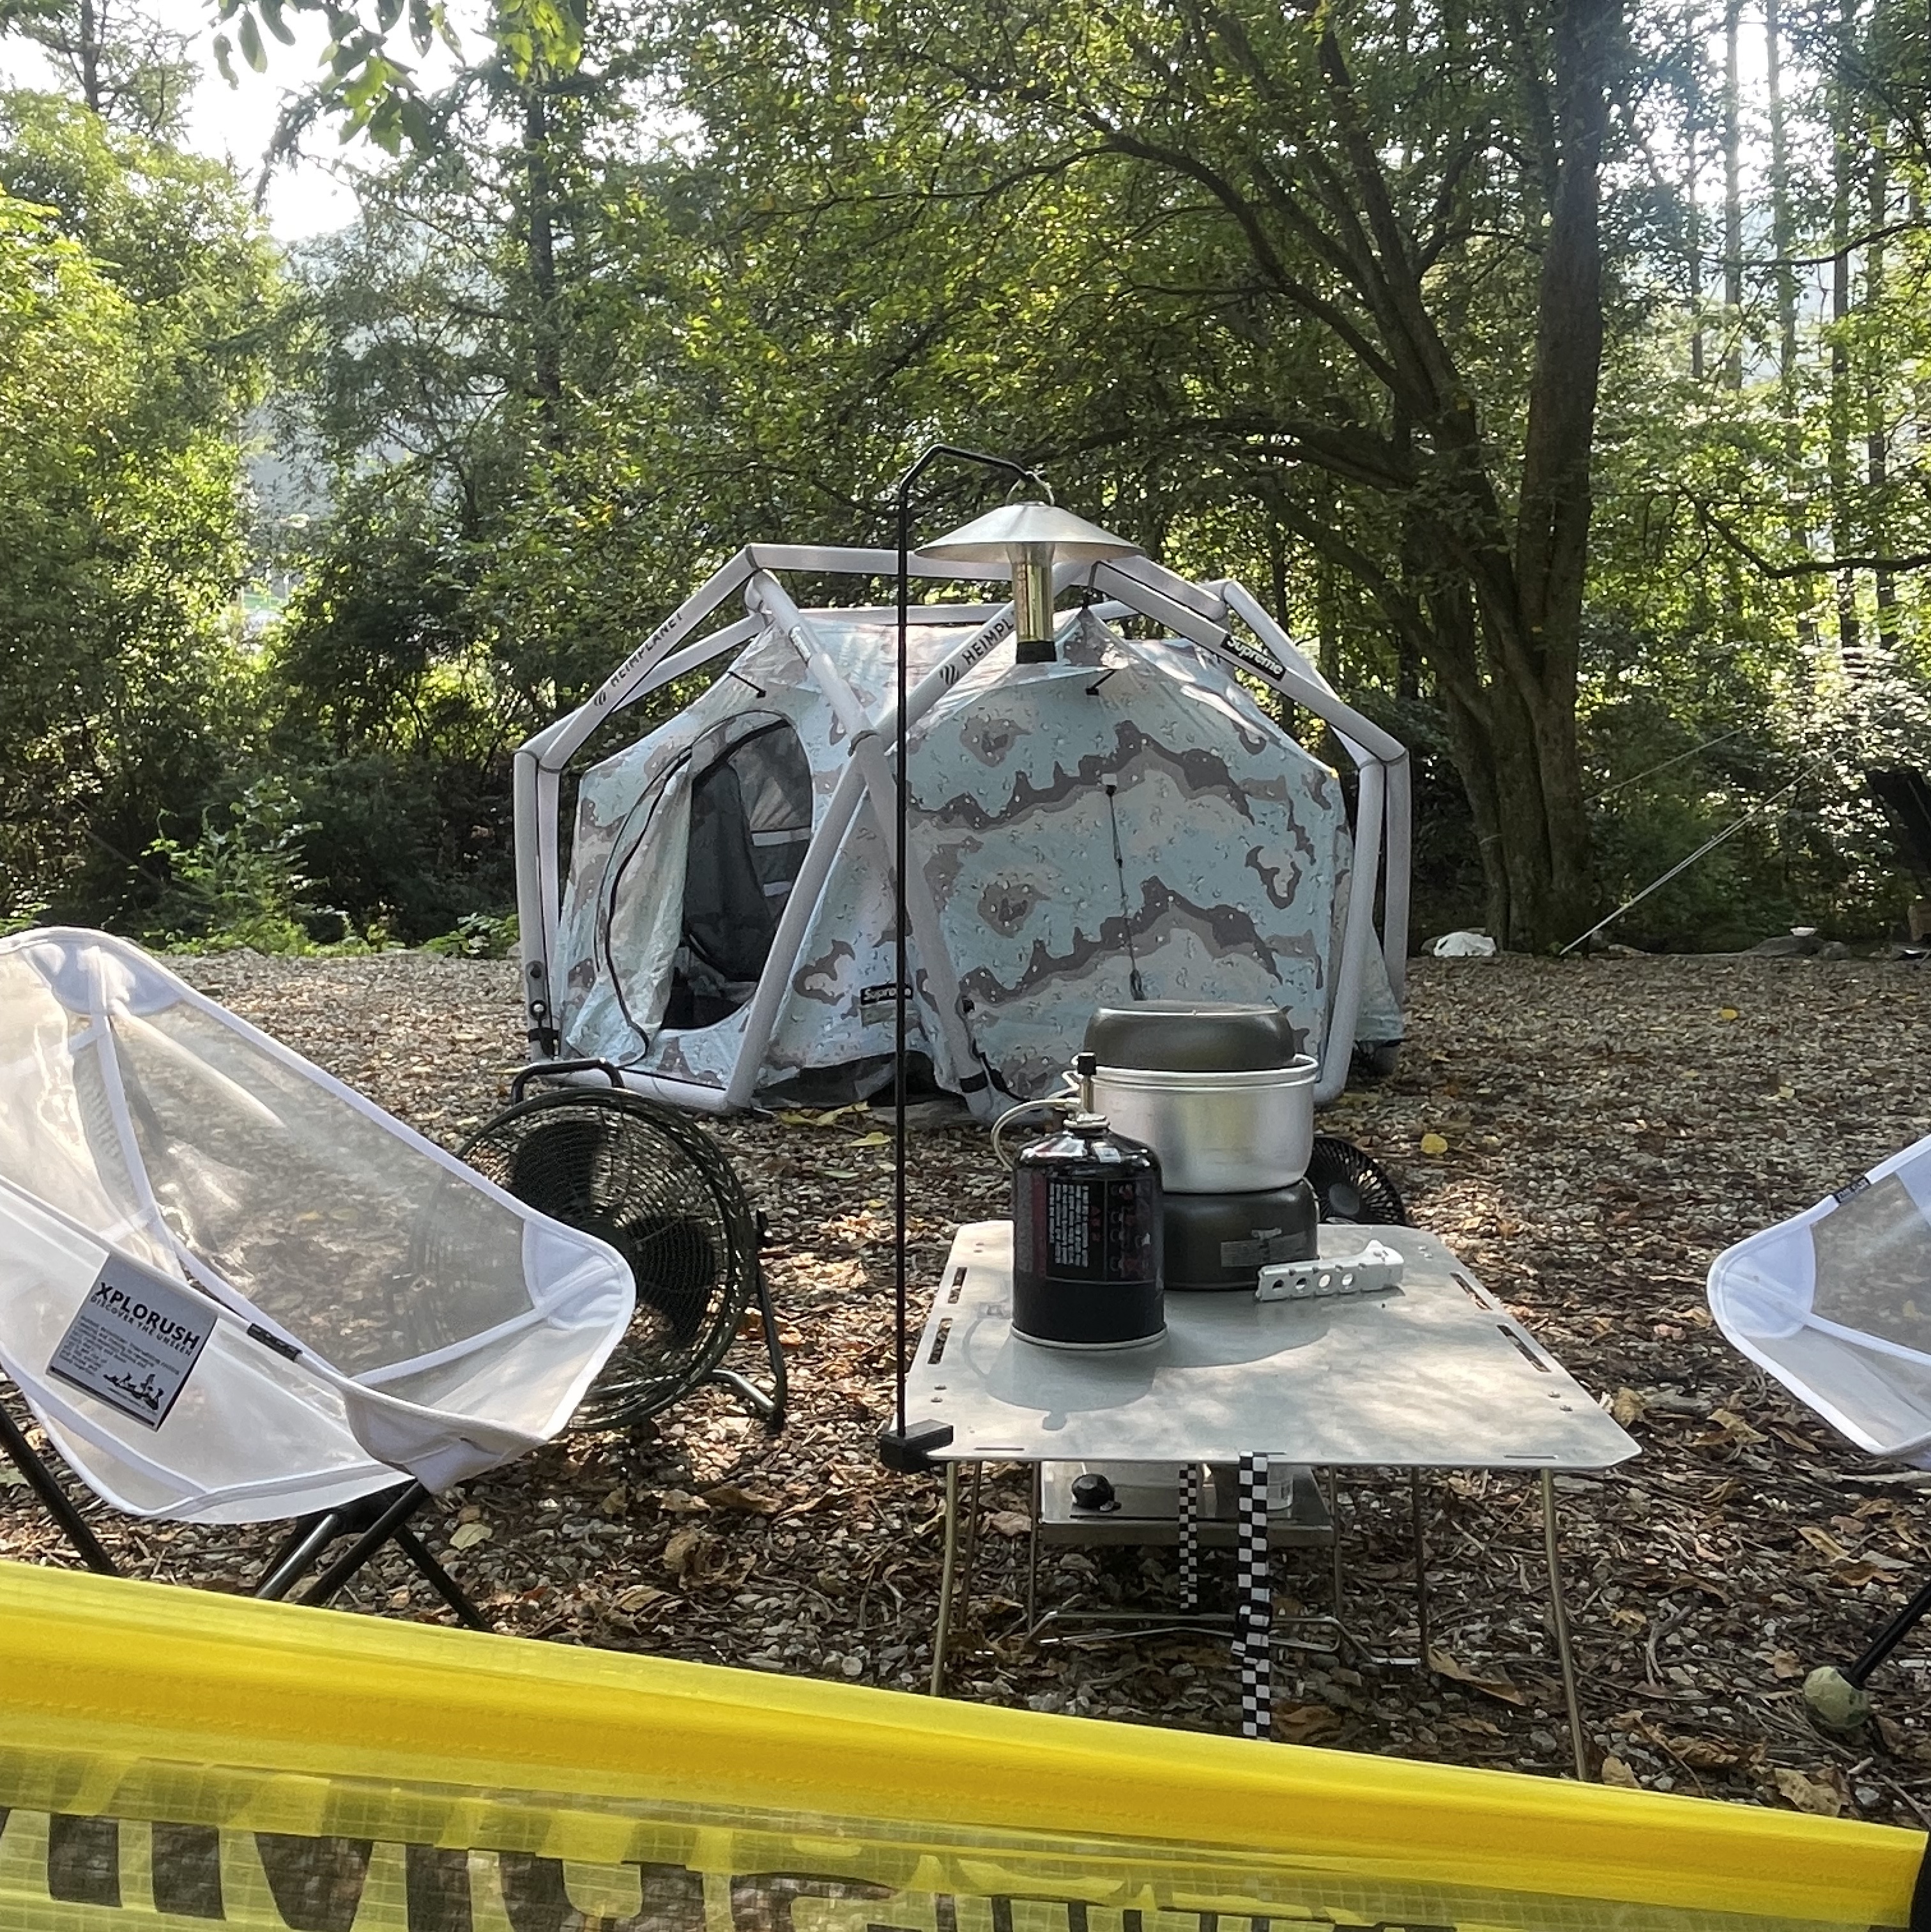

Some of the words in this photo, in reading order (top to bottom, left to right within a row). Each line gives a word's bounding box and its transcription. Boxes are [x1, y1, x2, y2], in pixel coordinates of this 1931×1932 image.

[610, 612, 683, 687] HEIMPLANET
[961, 613, 1015, 666] HEIMPL
[1227, 636, 1283, 675] Supreme
[864, 987, 912, 1002] Supree
[90, 1295, 134, 1324] DISCOVER
[137, 1321, 155, 1336] THE
[96, 1282, 201, 1351] XPLORUSH
